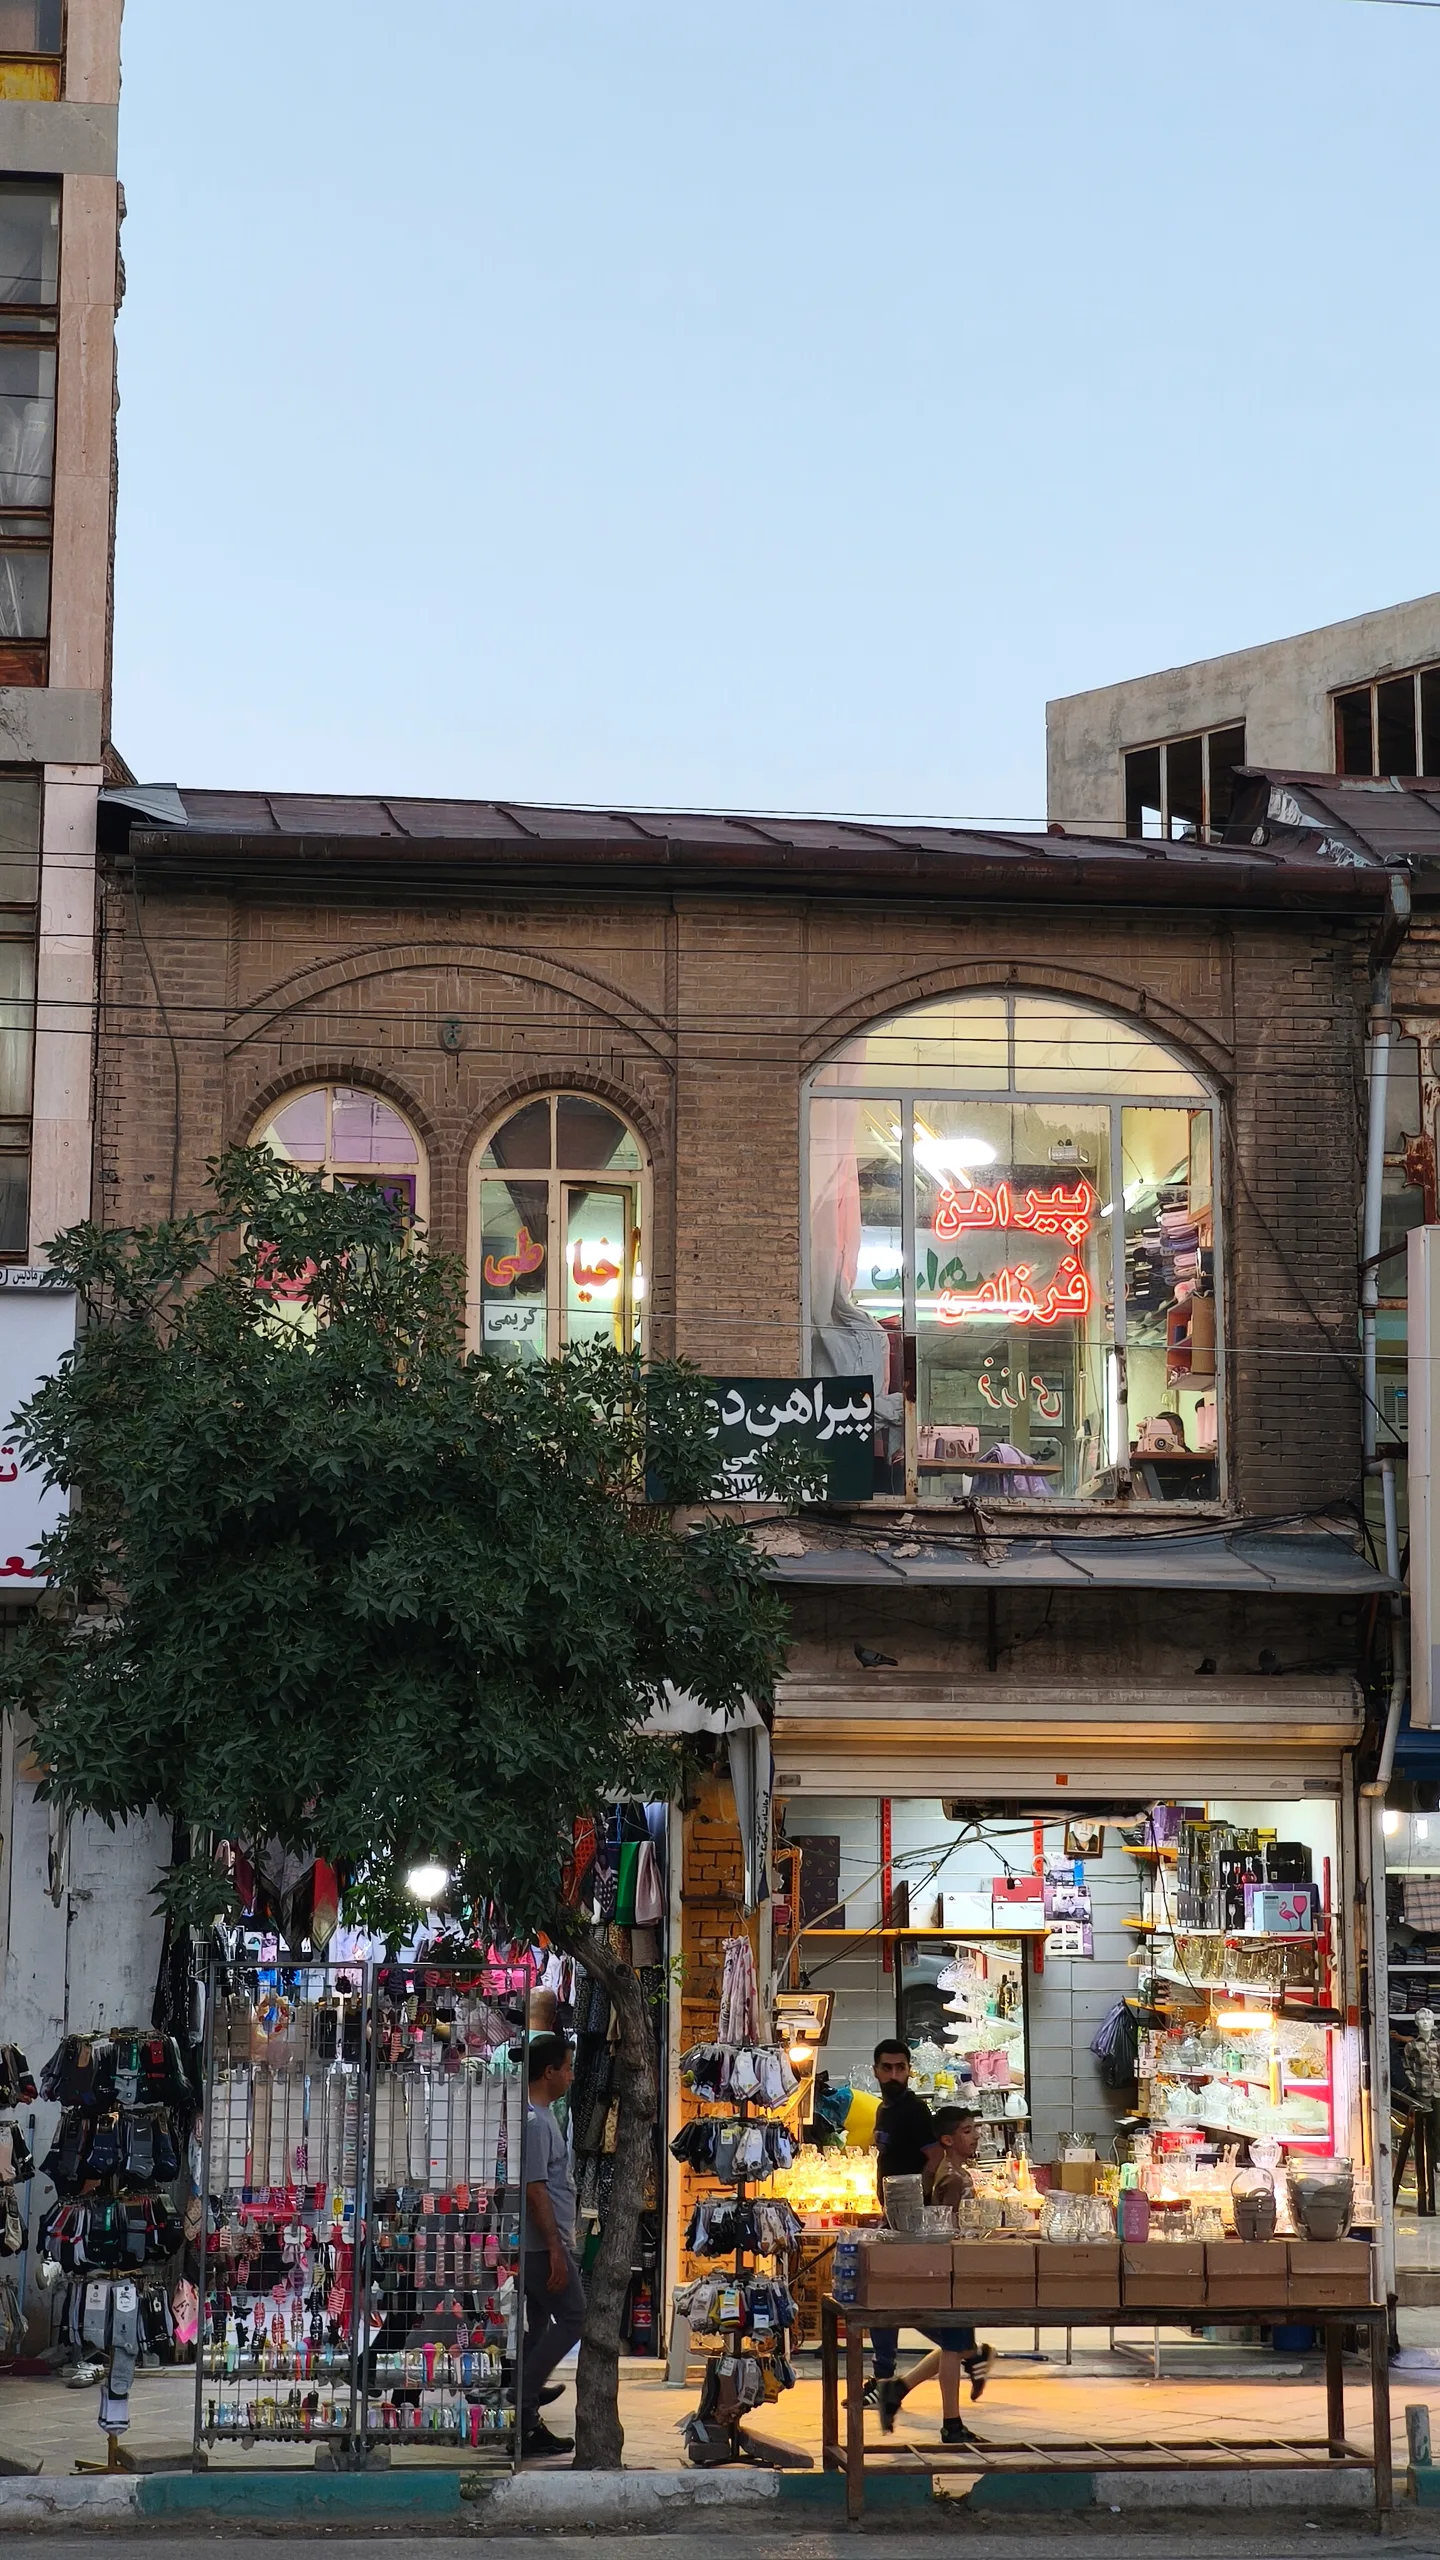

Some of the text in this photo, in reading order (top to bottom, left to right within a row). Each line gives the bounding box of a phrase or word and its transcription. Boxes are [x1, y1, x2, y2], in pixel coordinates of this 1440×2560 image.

[935, 1182, 1090, 1244] پیراهن
[488, 1307, 537, 1332] کریمی
[936, 1257, 1090, 1325] فرزامی
[745, 1381, 873, 1442] پیراهن
